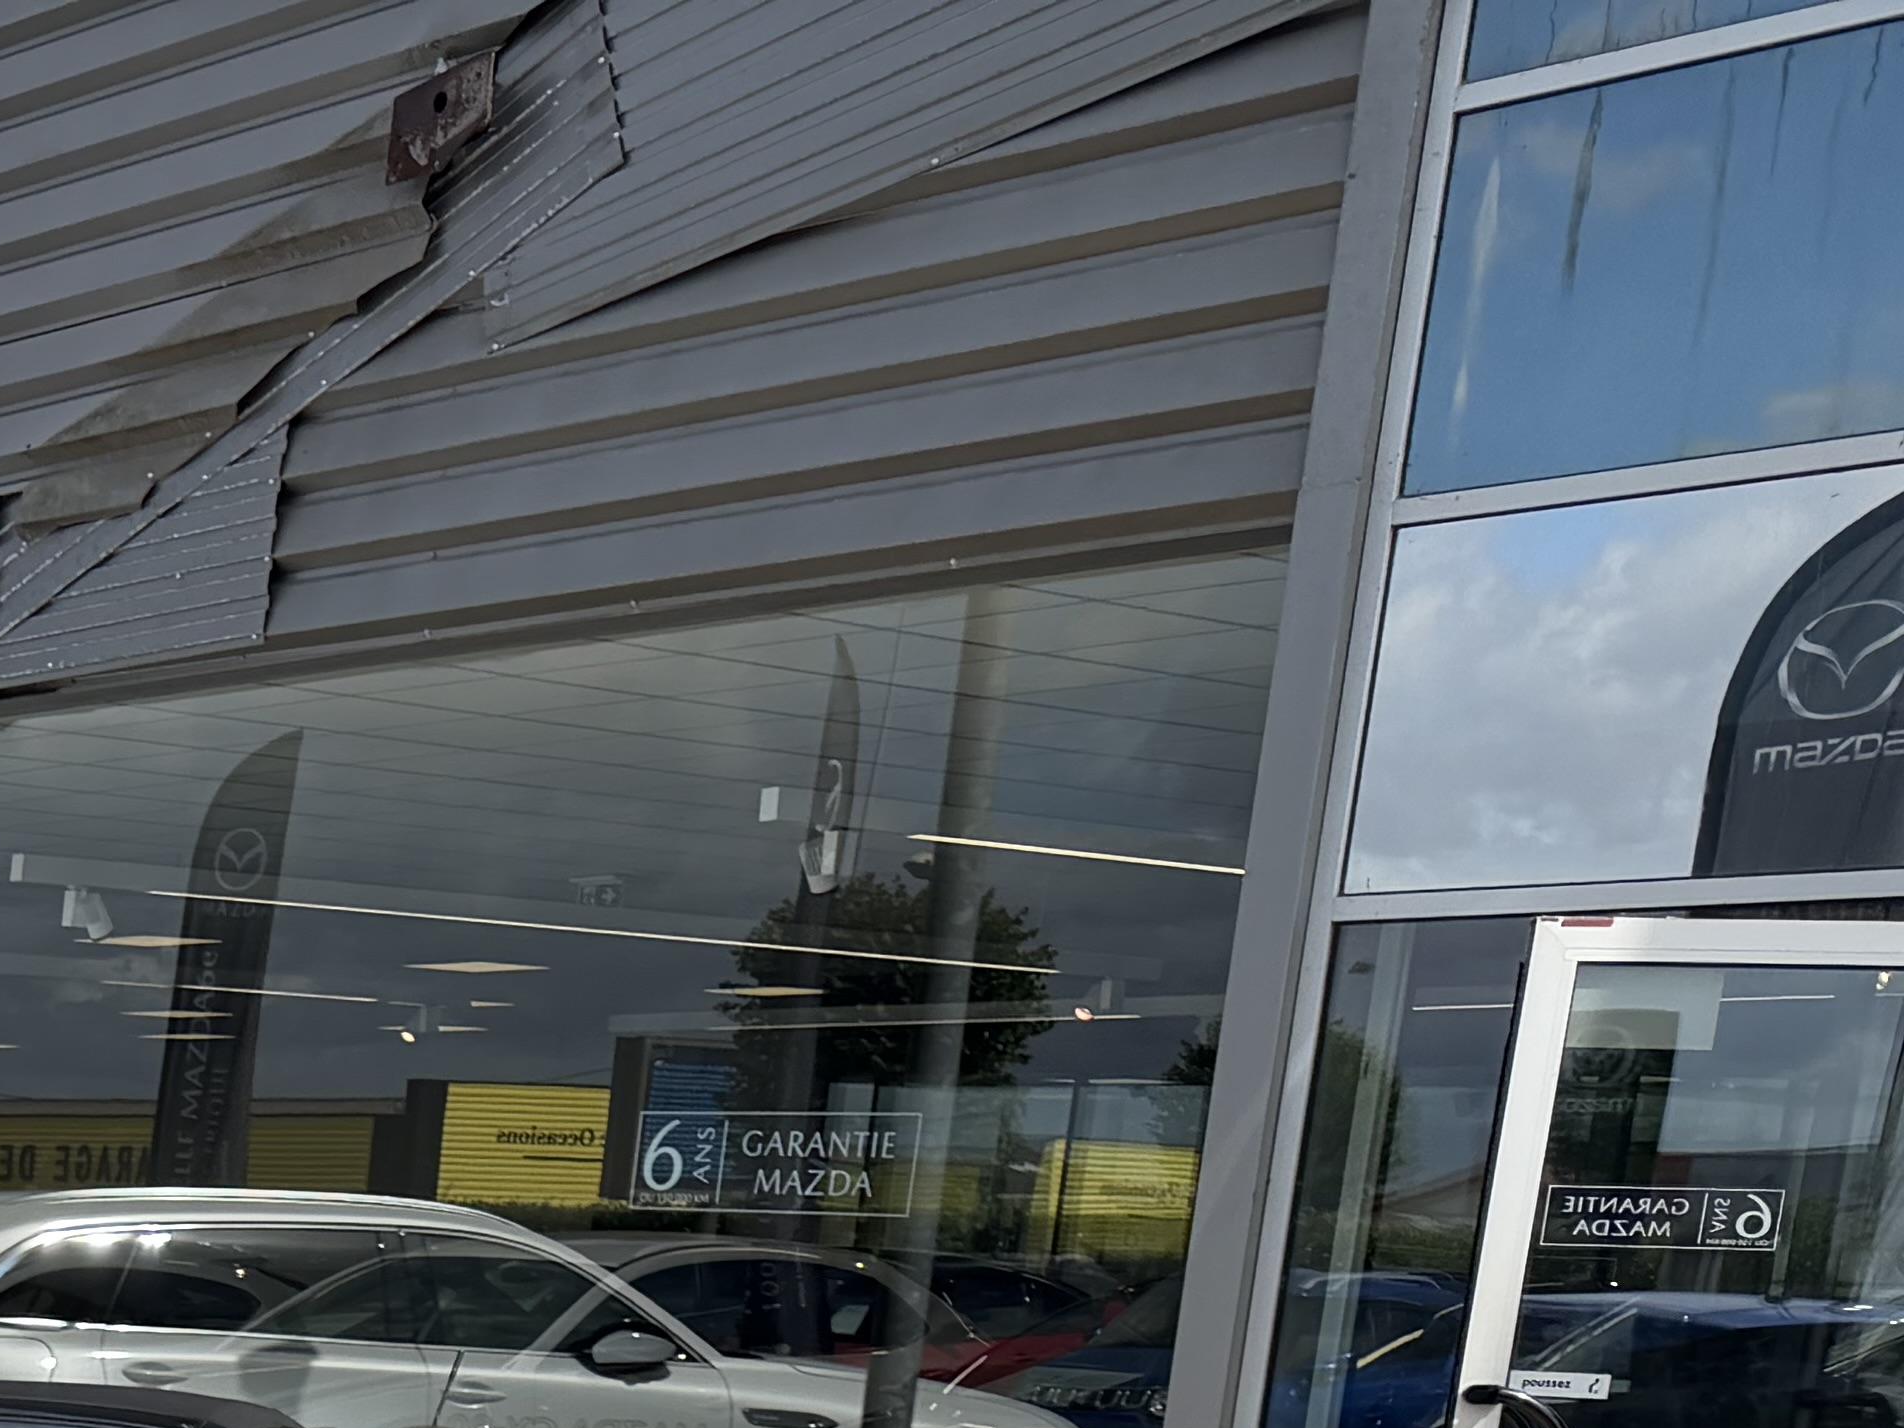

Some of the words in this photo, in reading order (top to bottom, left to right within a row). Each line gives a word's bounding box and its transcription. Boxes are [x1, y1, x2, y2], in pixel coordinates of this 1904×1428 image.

[642, 1119, 684, 1191] 6
[692, 1126, 717, 1185] ANS
[742, 1130, 897, 1160] GARANTIE
[753, 1168, 873, 1199] MAZDA
[1521, 1379, 1571, 1390] poussez
